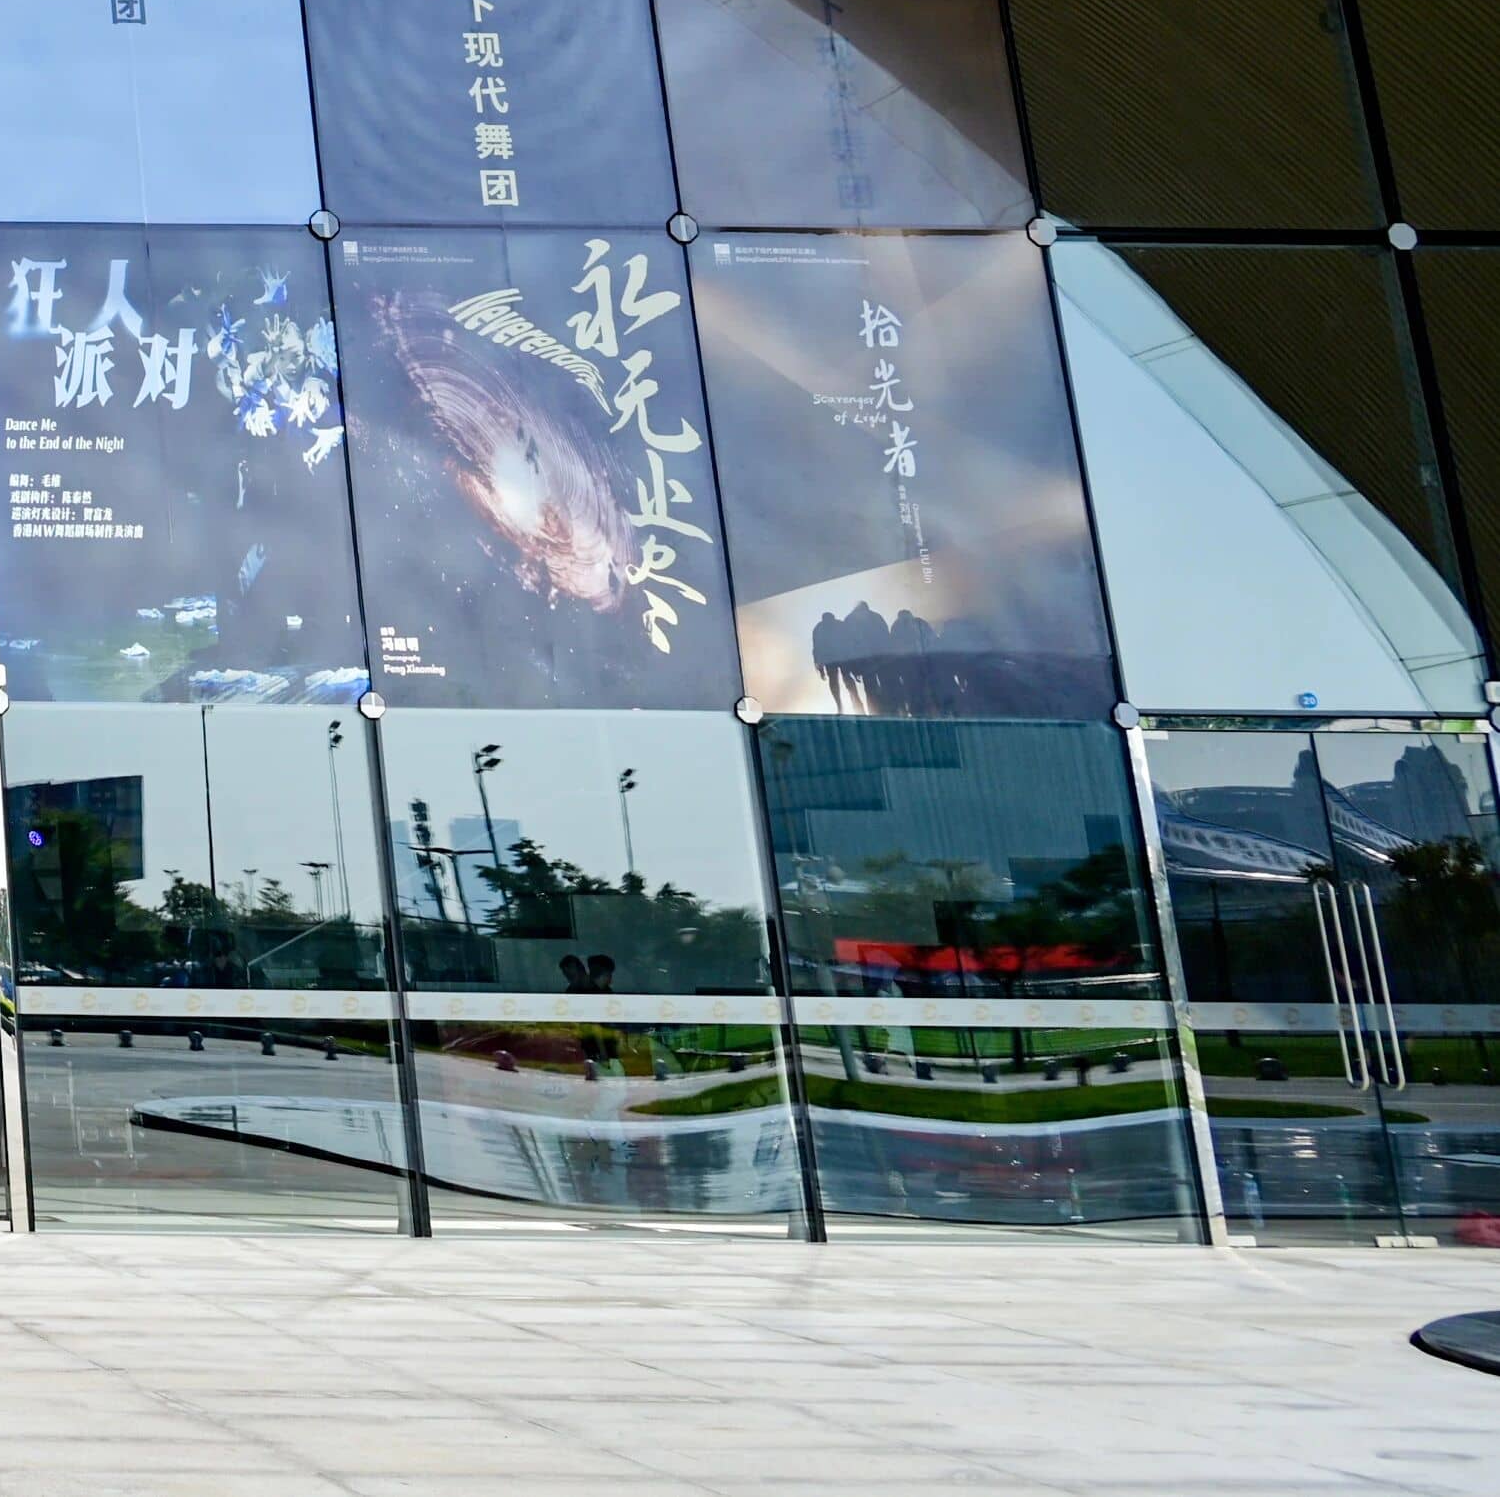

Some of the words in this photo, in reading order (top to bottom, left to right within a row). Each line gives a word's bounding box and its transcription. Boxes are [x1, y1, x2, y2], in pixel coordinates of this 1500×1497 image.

[8, 257, 144, 338] 狂人
[54, 328, 198, 409] 派对
[859, 299, 918, 477] 拾光者
[5, 418, 38, 431] Dance
[41, 418, 57, 431] Me
[6, 437, 16, 449] to
[20, 436, 36, 449] the
[40, 437, 60, 450] End
[62, 436, 73, 449] of
[76, 436, 92, 450] the
[96, 437, 124, 453] Night
